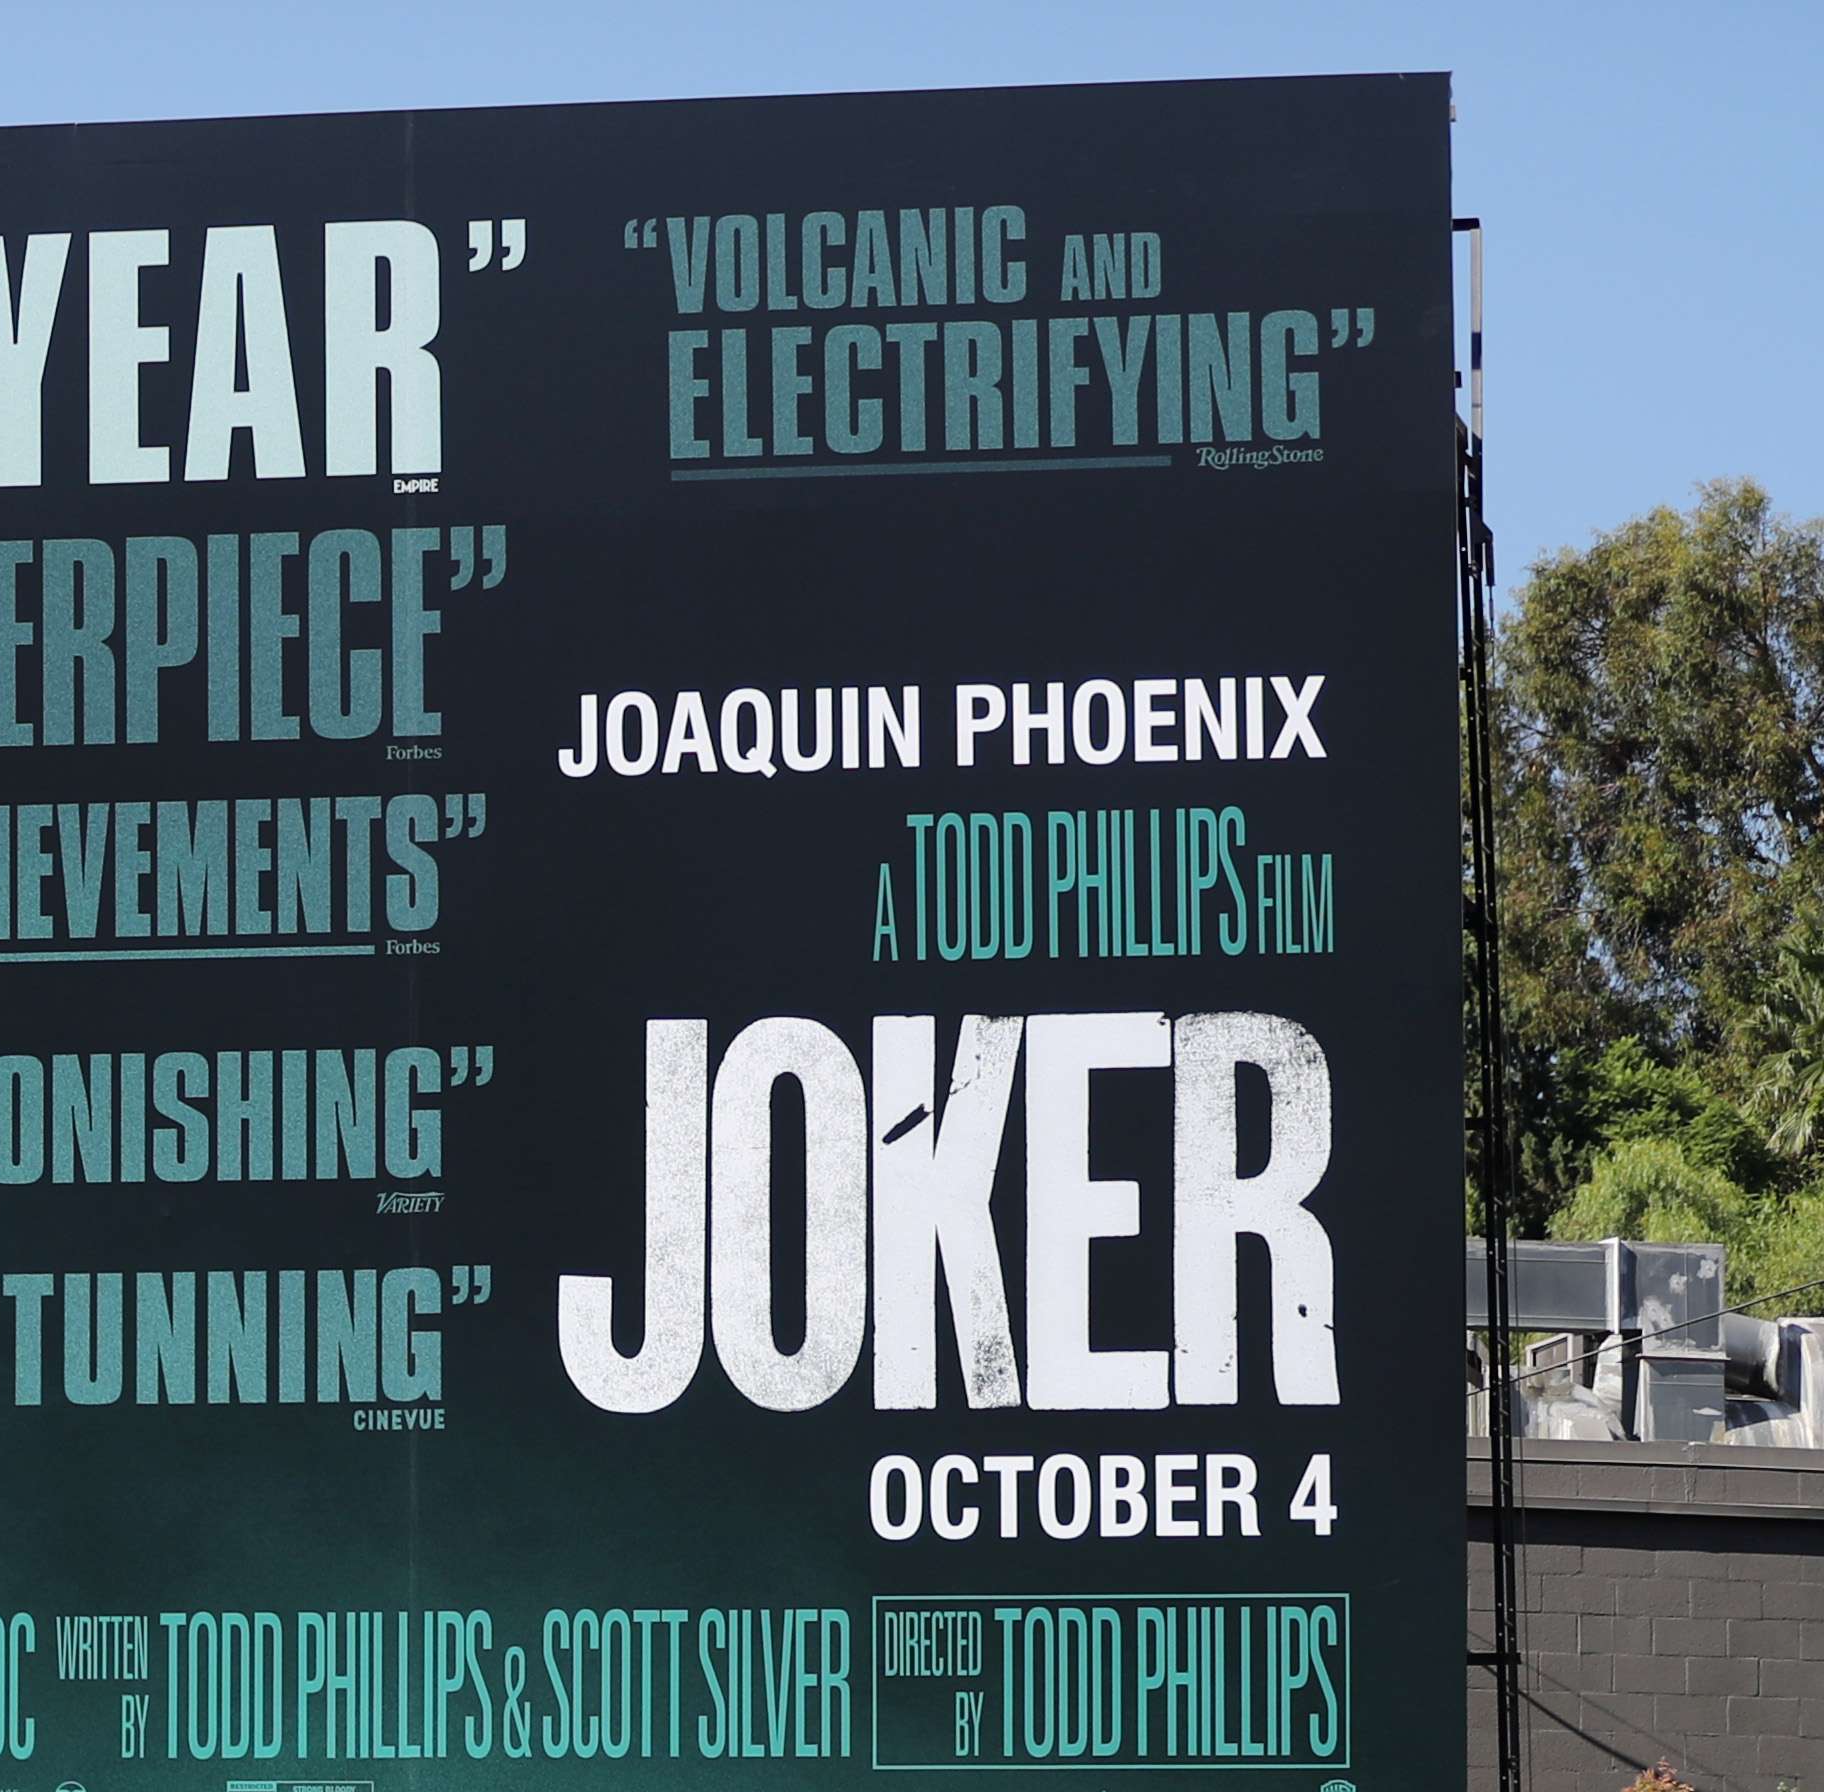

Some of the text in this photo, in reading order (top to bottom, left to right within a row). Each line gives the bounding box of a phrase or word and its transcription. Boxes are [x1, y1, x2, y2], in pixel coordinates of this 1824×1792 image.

[623, 205, 1161, 314] “VOLCANIC AND
[668, 307, 1375, 459] ELECTRIFYING”
[393, 478, 440, 494] EMPIRE
[386, 745, 442, 760] Forbes
[558, 675, 1328, 780] JOAQUIN PHOENIX
[872, 806, 1334, 962] A TODD PHILLIPS FILM
[386, 938, 441, 955] Forbes
[558, 1010, 1341, 1413] JOKER
[353, 1409, 446, 1431] CINEVUE
[869, 1453, 1338, 1541] OCTOBER 4
[56, 1615, 148, 1680] WRITTEN
[884, 1610, 982, 1677] DIRECTED
[994, 1604, 1338, 1758] TODD PHILLIPS
[160, 1607, 852, 1760] TODD PHILLIPS & SCOTT SILVER
[121, 1694, 150, 1759] BY
[955, 1691, 983, 1756] BY
